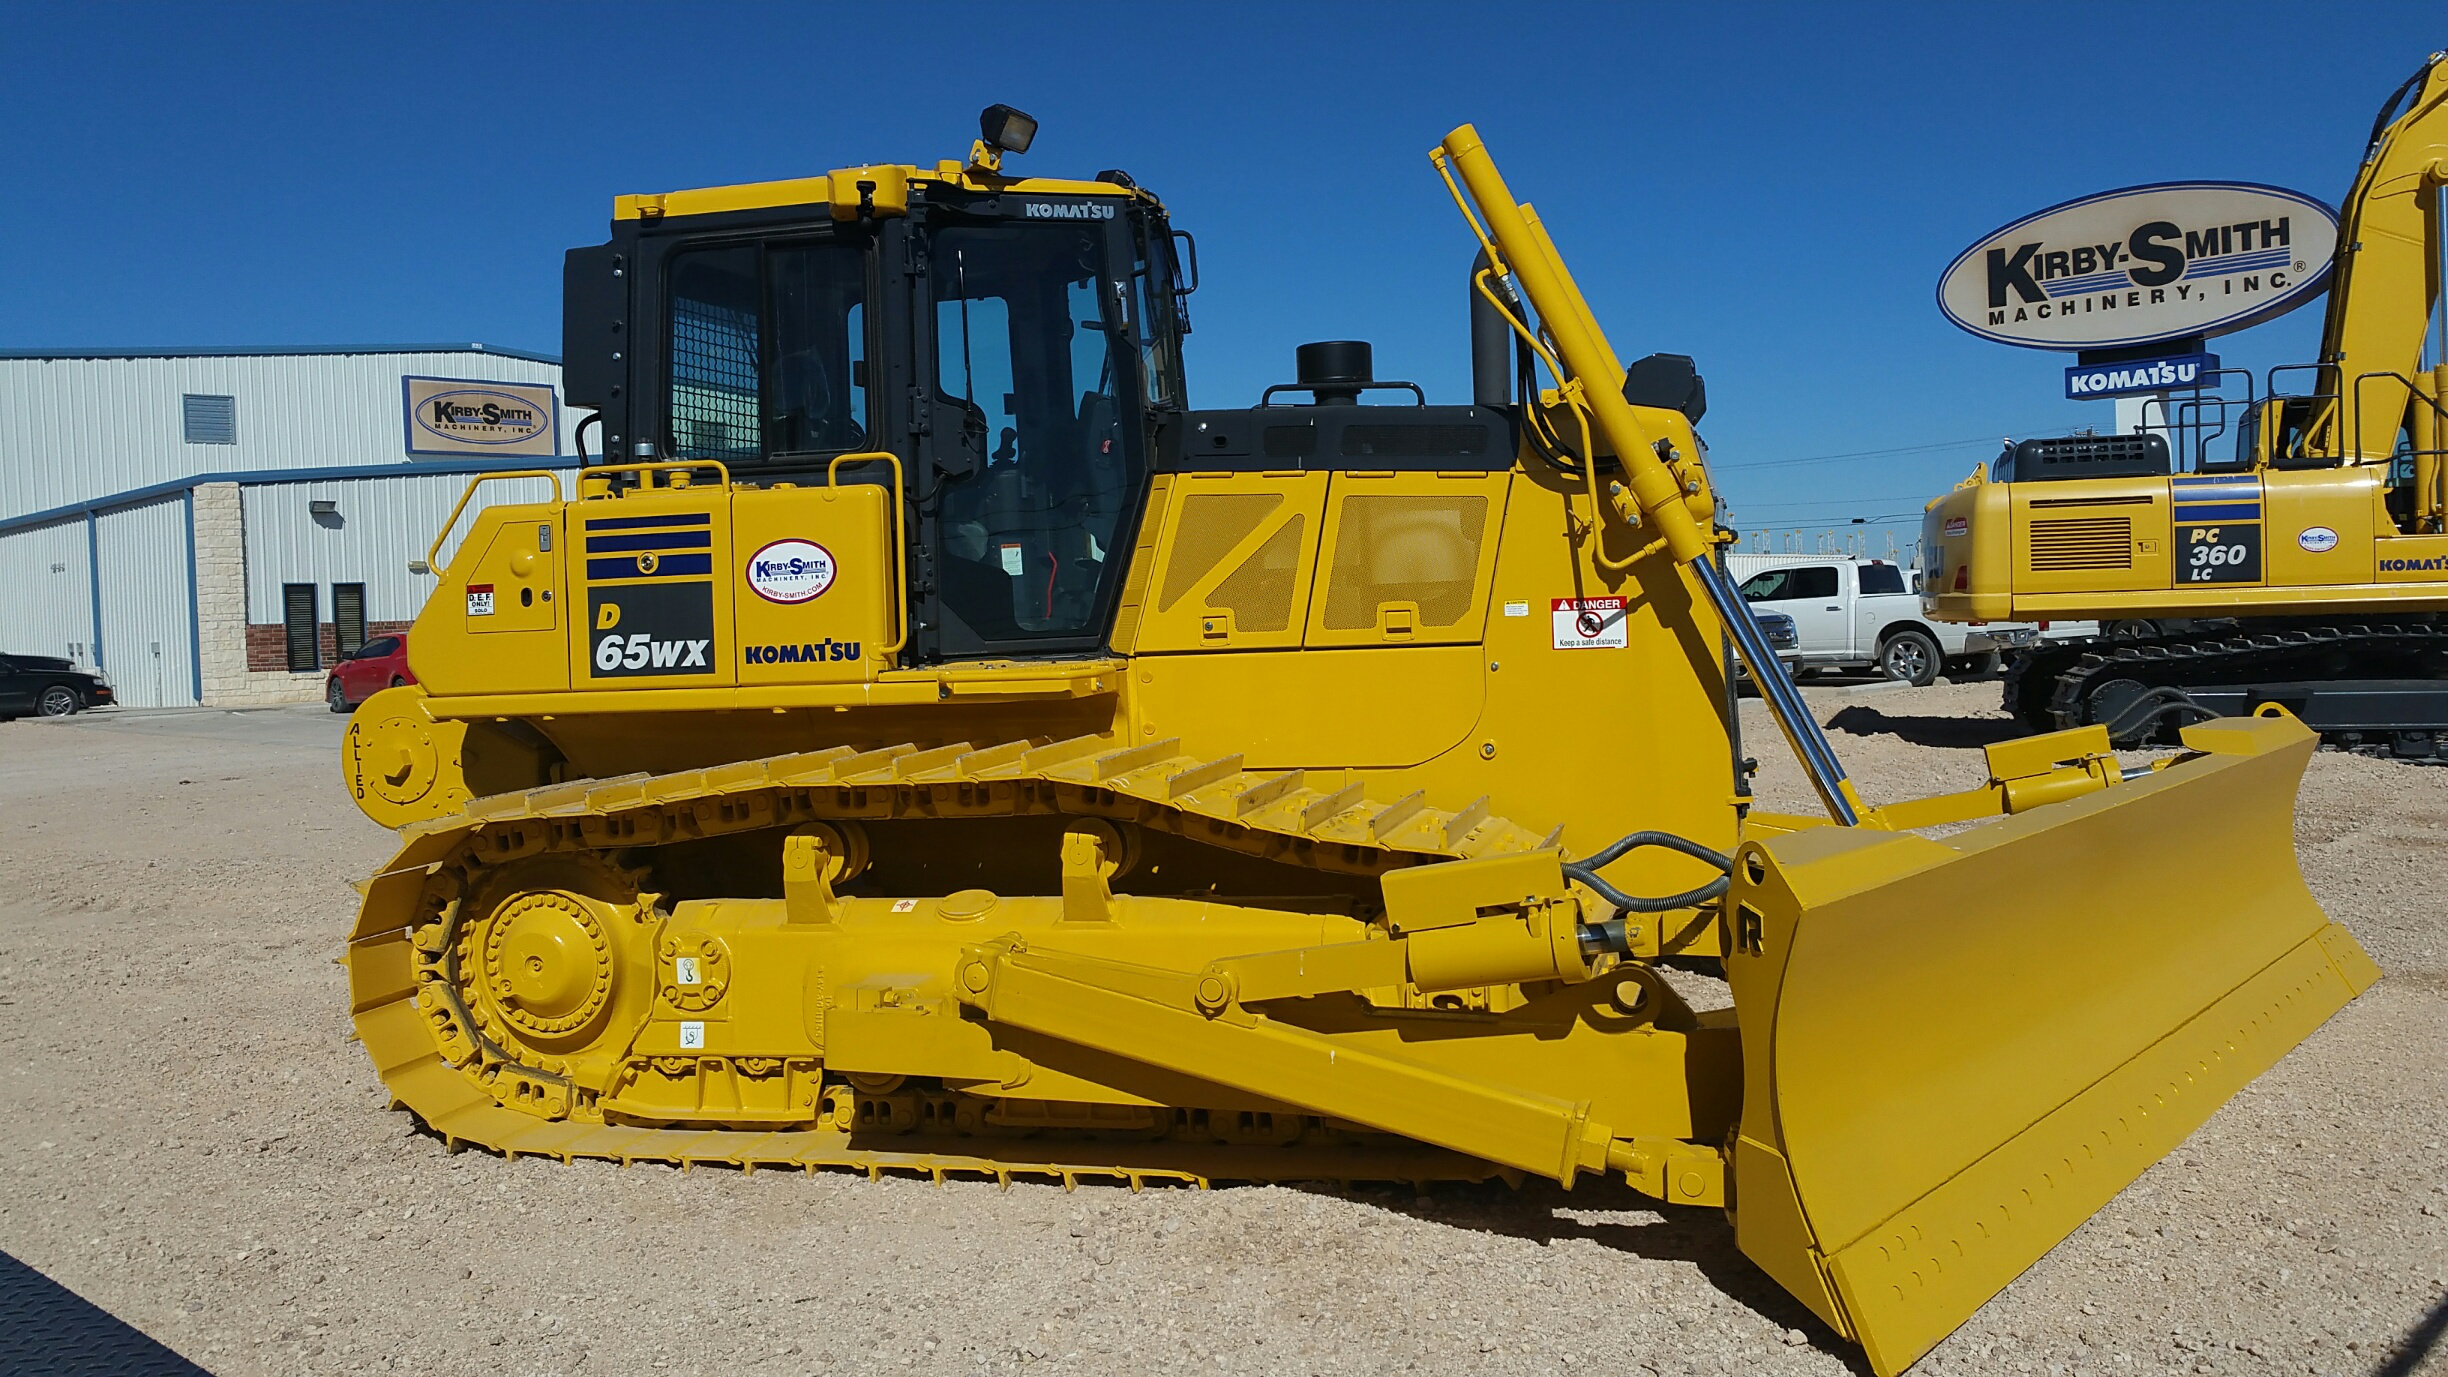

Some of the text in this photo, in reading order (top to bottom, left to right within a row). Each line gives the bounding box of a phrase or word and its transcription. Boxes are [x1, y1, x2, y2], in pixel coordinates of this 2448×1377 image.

[1026, 201, 1115, 219] KOMATSU
[1987, 217, 2290, 308] KIRBY-SMITH
[1988, 272, 2292, 325] MACHINERY, INC.
[2071, 361, 2196, 394] KOMATSU
[434, 401, 532, 425] KIRBY-SMITH
[434, 423, 507, 433] MACHINERY,
[2190, 528, 2220, 543] PC
[2189, 544, 2247, 566] 360
[2380, 555, 2448, 571] KOMAT
[756, 558, 826, 577] KIRBY-SMITH
[2191, 568, 2213, 580] LC
[761, 581, 823, 599] KIRBY-SMITH.COM
[1573, 599, 1620, 609] DANGER
[596, 603, 621, 629] D
[596, 633, 709, 670] 65WX
[745, 638, 860, 664] KOMATSU
[1560, 639, 1575, 647] Keep
[1596, 638, 1622, 646] distance
[349, 722, 365, 799] ALLIED
[1736, 899, 1765, 957] R
